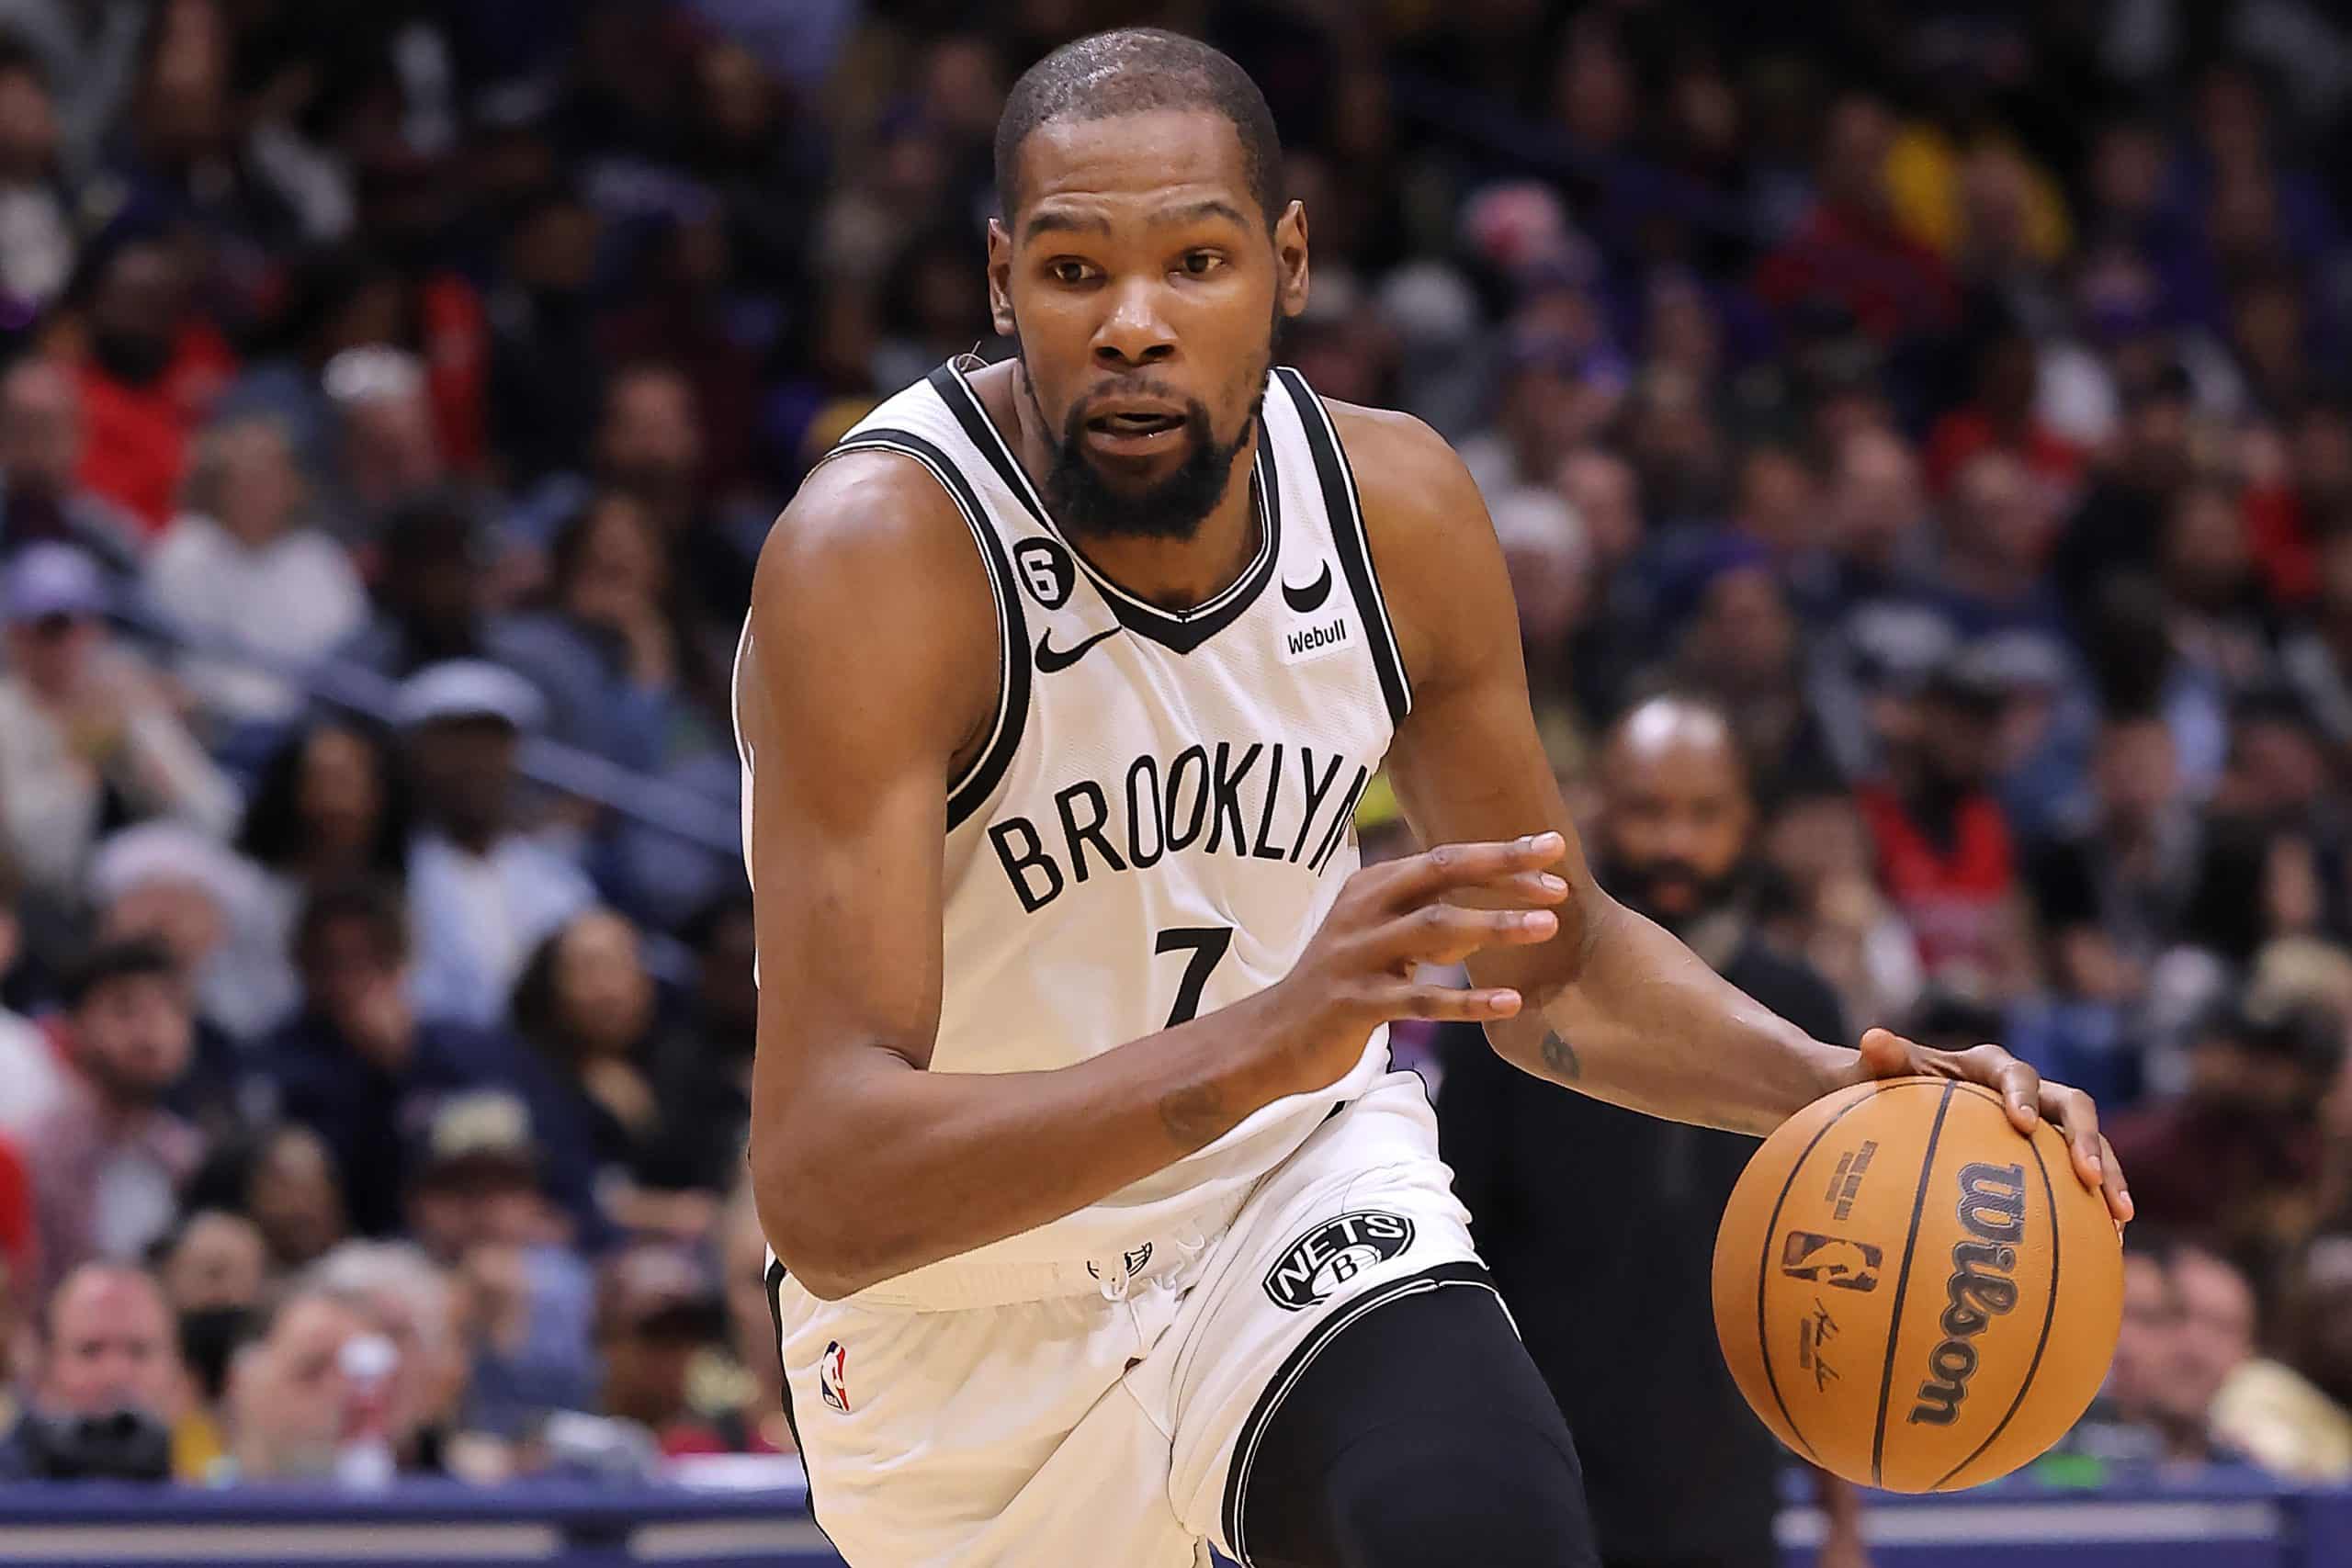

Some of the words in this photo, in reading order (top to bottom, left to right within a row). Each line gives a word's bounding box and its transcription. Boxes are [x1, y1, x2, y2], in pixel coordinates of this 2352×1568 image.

[1020, 547, 1059, 602] 6
[1286, 618, 1347, 655] Webull
[1154, 927, 1234, 1032] 7
[1276, 1214, 1405, 1301] NETS
[1331, 1254, 1359, 1284] B
[1906, 1161, 2026, 1427] Wilson
